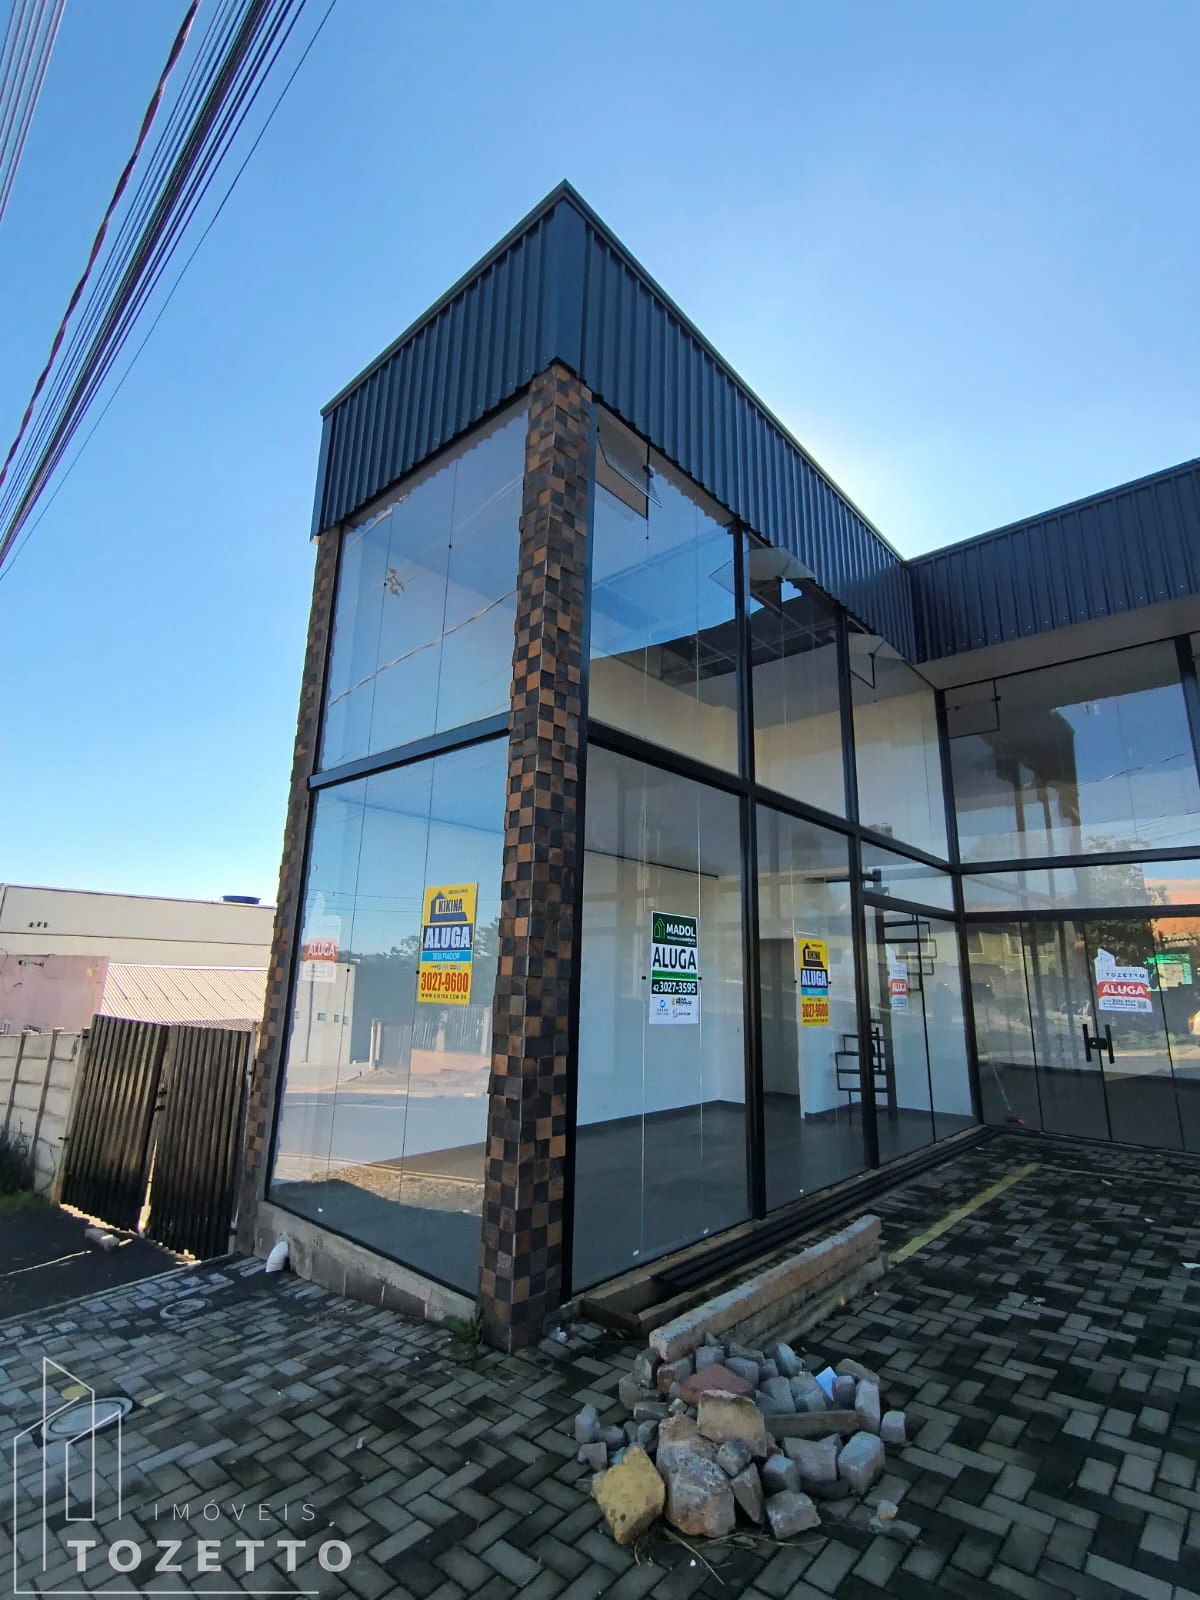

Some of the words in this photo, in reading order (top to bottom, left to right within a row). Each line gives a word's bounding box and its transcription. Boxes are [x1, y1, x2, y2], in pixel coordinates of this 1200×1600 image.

[438, 898, 463, 913] KIKINA
[423, 926, 471, 949] ALUGA
[666, 923, 696, 937] MADOL
[307, 943, 335, 956] ALUGA
[652, 946, 697, 970] ALUGA
[420, 971, 469, 993] 3027-9600
[801, 969, 827, 987] ALUGA
[659, 981, 697, 993] 3027-3595
[1102, 983, 1146, 995] ALUGA
